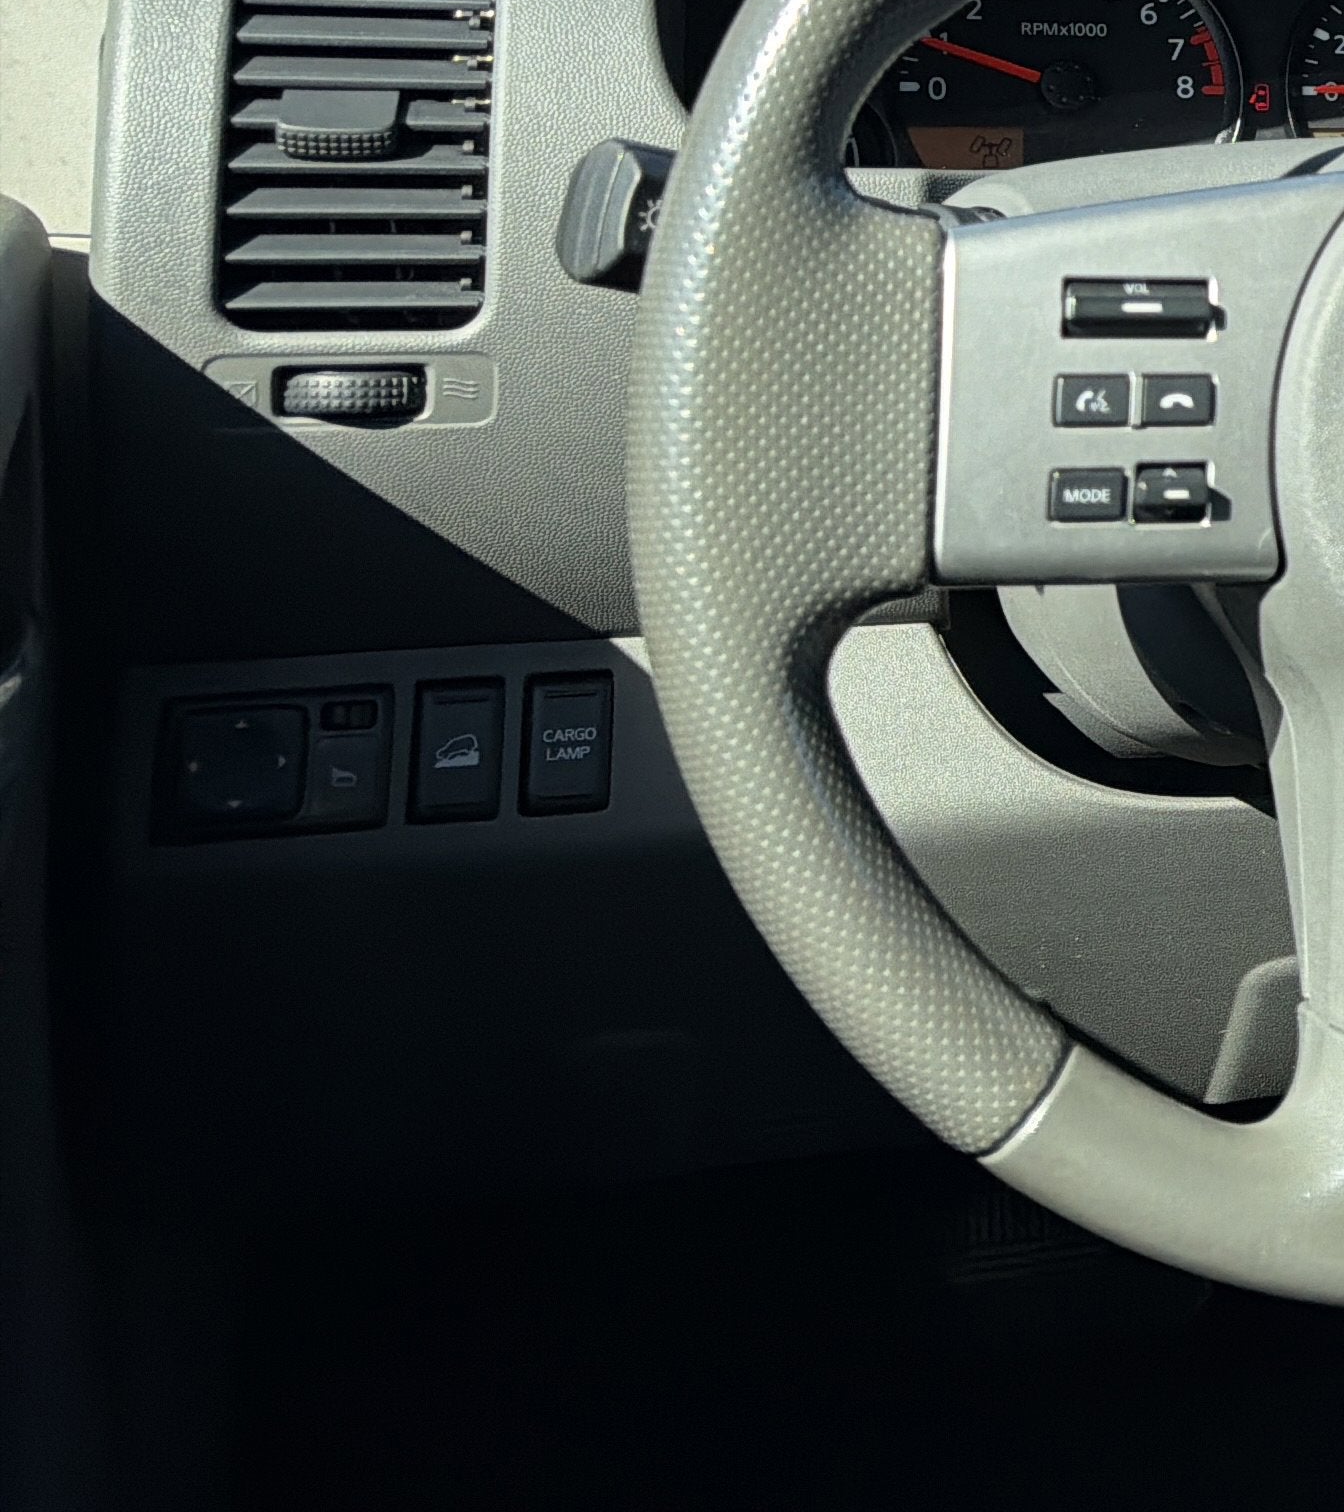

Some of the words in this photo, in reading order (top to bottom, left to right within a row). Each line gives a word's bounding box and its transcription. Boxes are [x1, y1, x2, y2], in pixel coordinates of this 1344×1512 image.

[1140, 2, 1158, 25] 6
[1021, 21, 1108, 37] RPMx1000
[1167, 38, 1185, 61] 7
[928, 76, 947, 100] 0
[1176, 75, 1195, 99] 8
[1123, 283, 1151, 295] VOL
[1062, 488, 1112, 503] MODE
[542, 726, 597, 743] CARGO
[545, 745, 591, 762] LAMP
